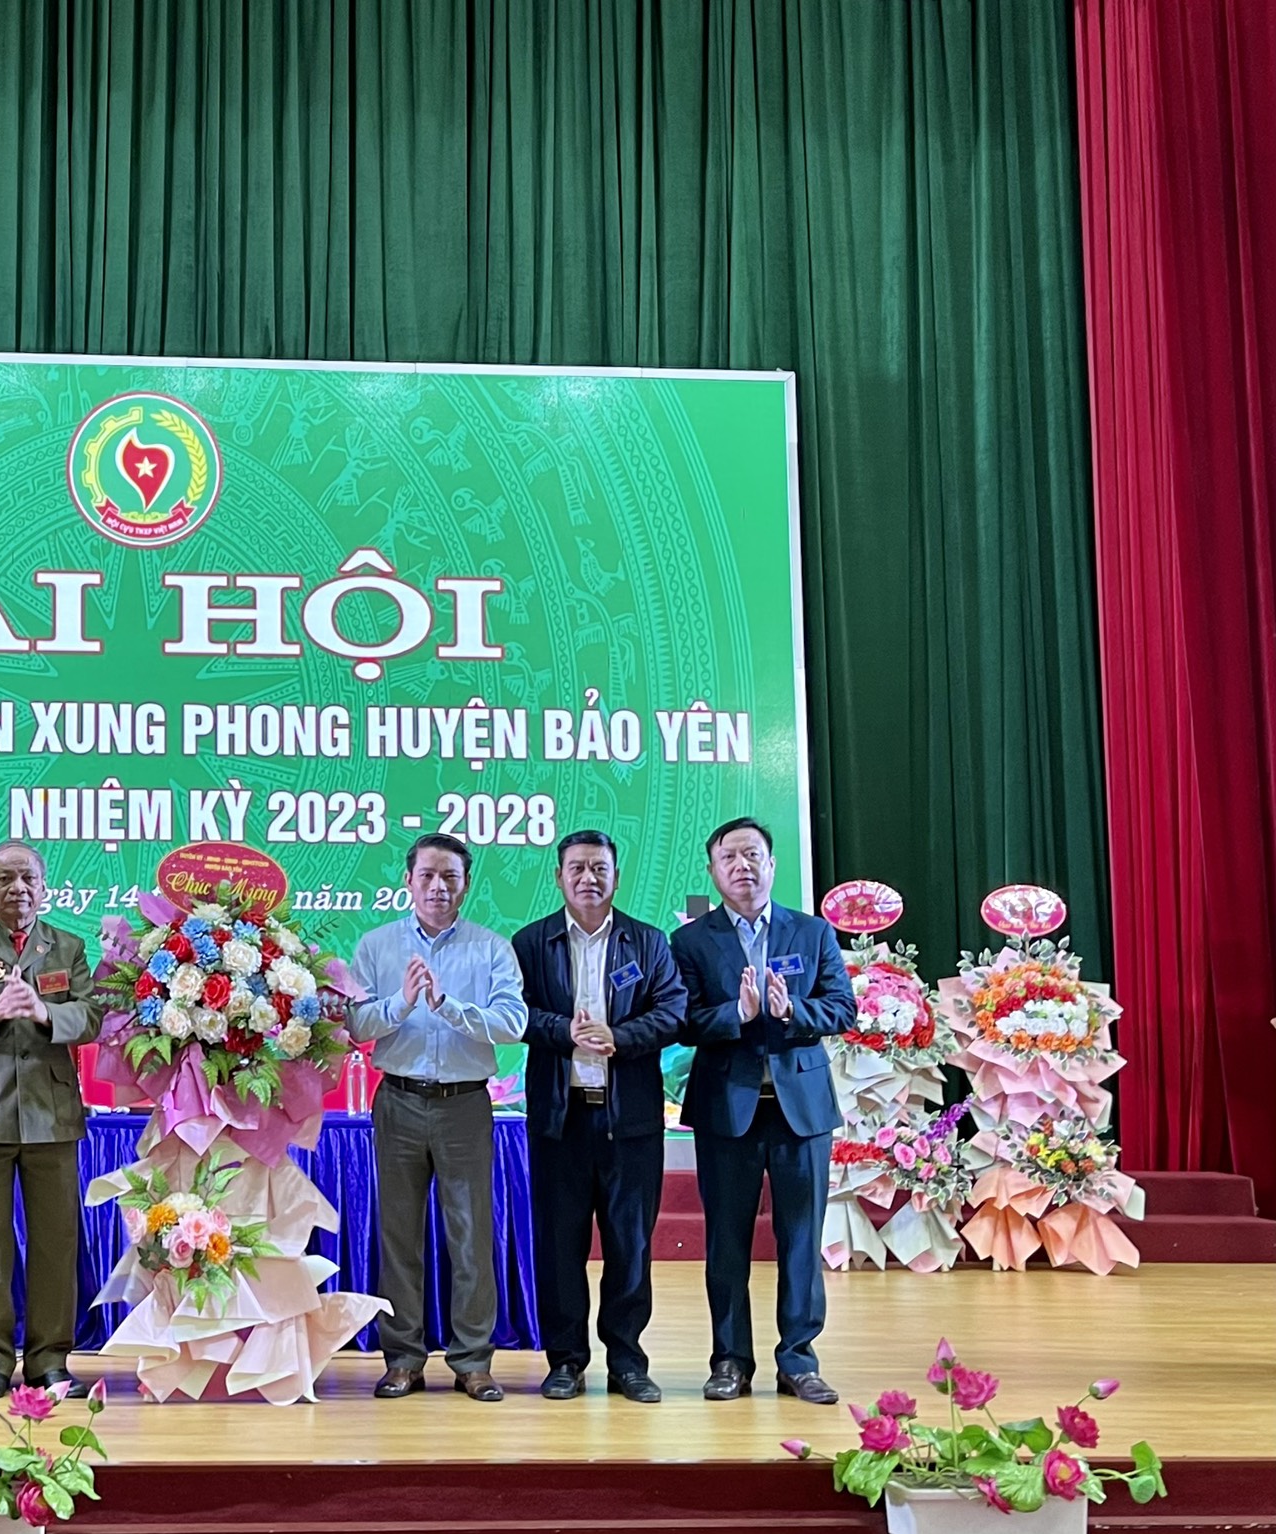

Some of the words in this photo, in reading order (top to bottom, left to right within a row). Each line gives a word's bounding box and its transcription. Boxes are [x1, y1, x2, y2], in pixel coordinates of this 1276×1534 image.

[163, 547, 504, 681] HỘI
[29, 702, 166, 755] XUNG
[182, 704, 351, 758] PHONG
[366, 697, 528, 770] HUYỆN
[544, 688, 641, 762] BẢO
[658, 701, 751, 764] YÊN
[9, 777, 173, 852] NHIỆM
[189, 779, 253, 842] KỲ
[266, 791, 387, 844] 2023
[403, 815, 422, 828] -
[437, 793, 556, 847] 2028
[36, 880, 99, 915] gày
[104, 884, 139, 908] 14
[291, 884, 363, 911] năm
[166, 871, 212, 895] Chúc
[230, 878, 278, 911] Mừng
